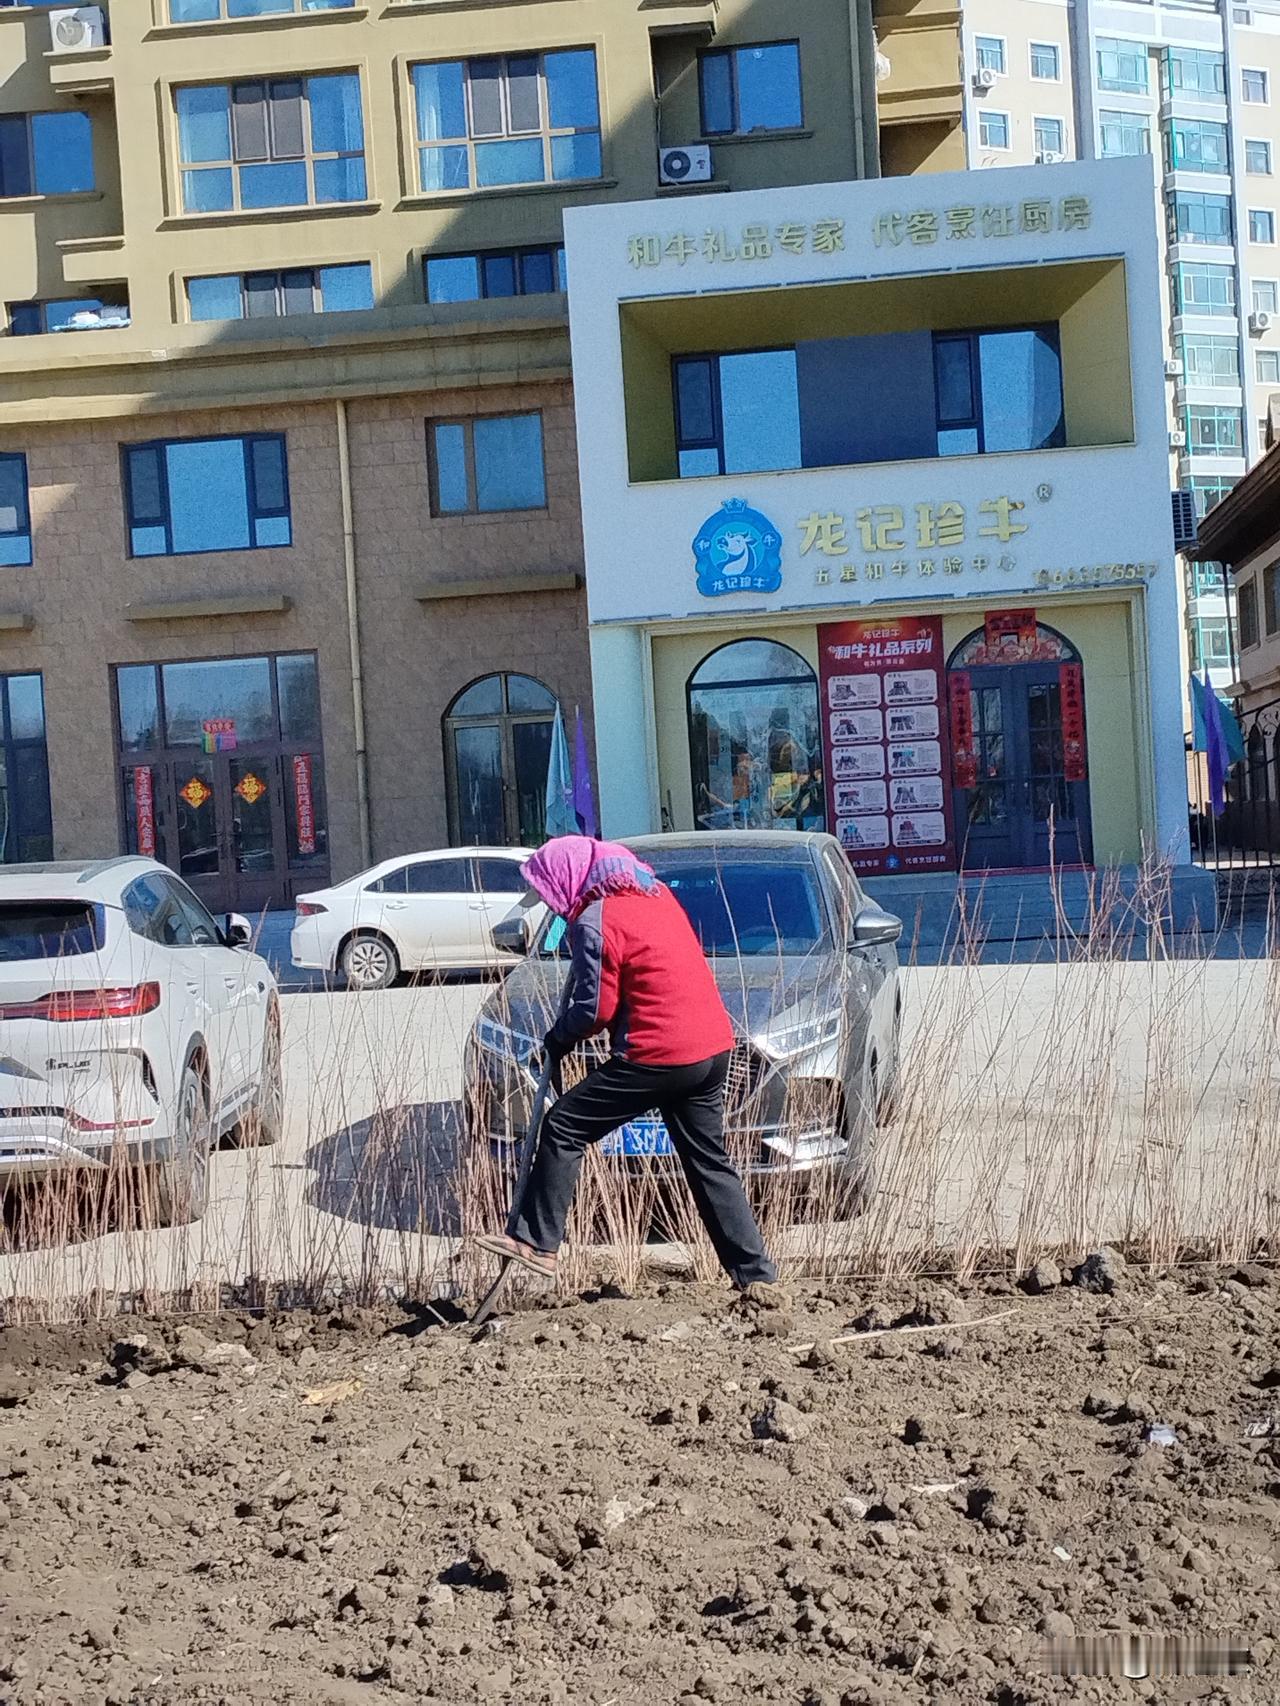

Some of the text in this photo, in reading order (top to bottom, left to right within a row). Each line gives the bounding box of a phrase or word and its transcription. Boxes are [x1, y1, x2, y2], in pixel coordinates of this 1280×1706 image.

[627, 195, 1093, 267] 和牛礼品专家 代客烹饪厨房
[797, 495, 1029, 556] 龙记珍牛
[816, 553, 1018, 586] 五星和牛体验中心
[834, 638, 932, 660] 和牛礼品系列
